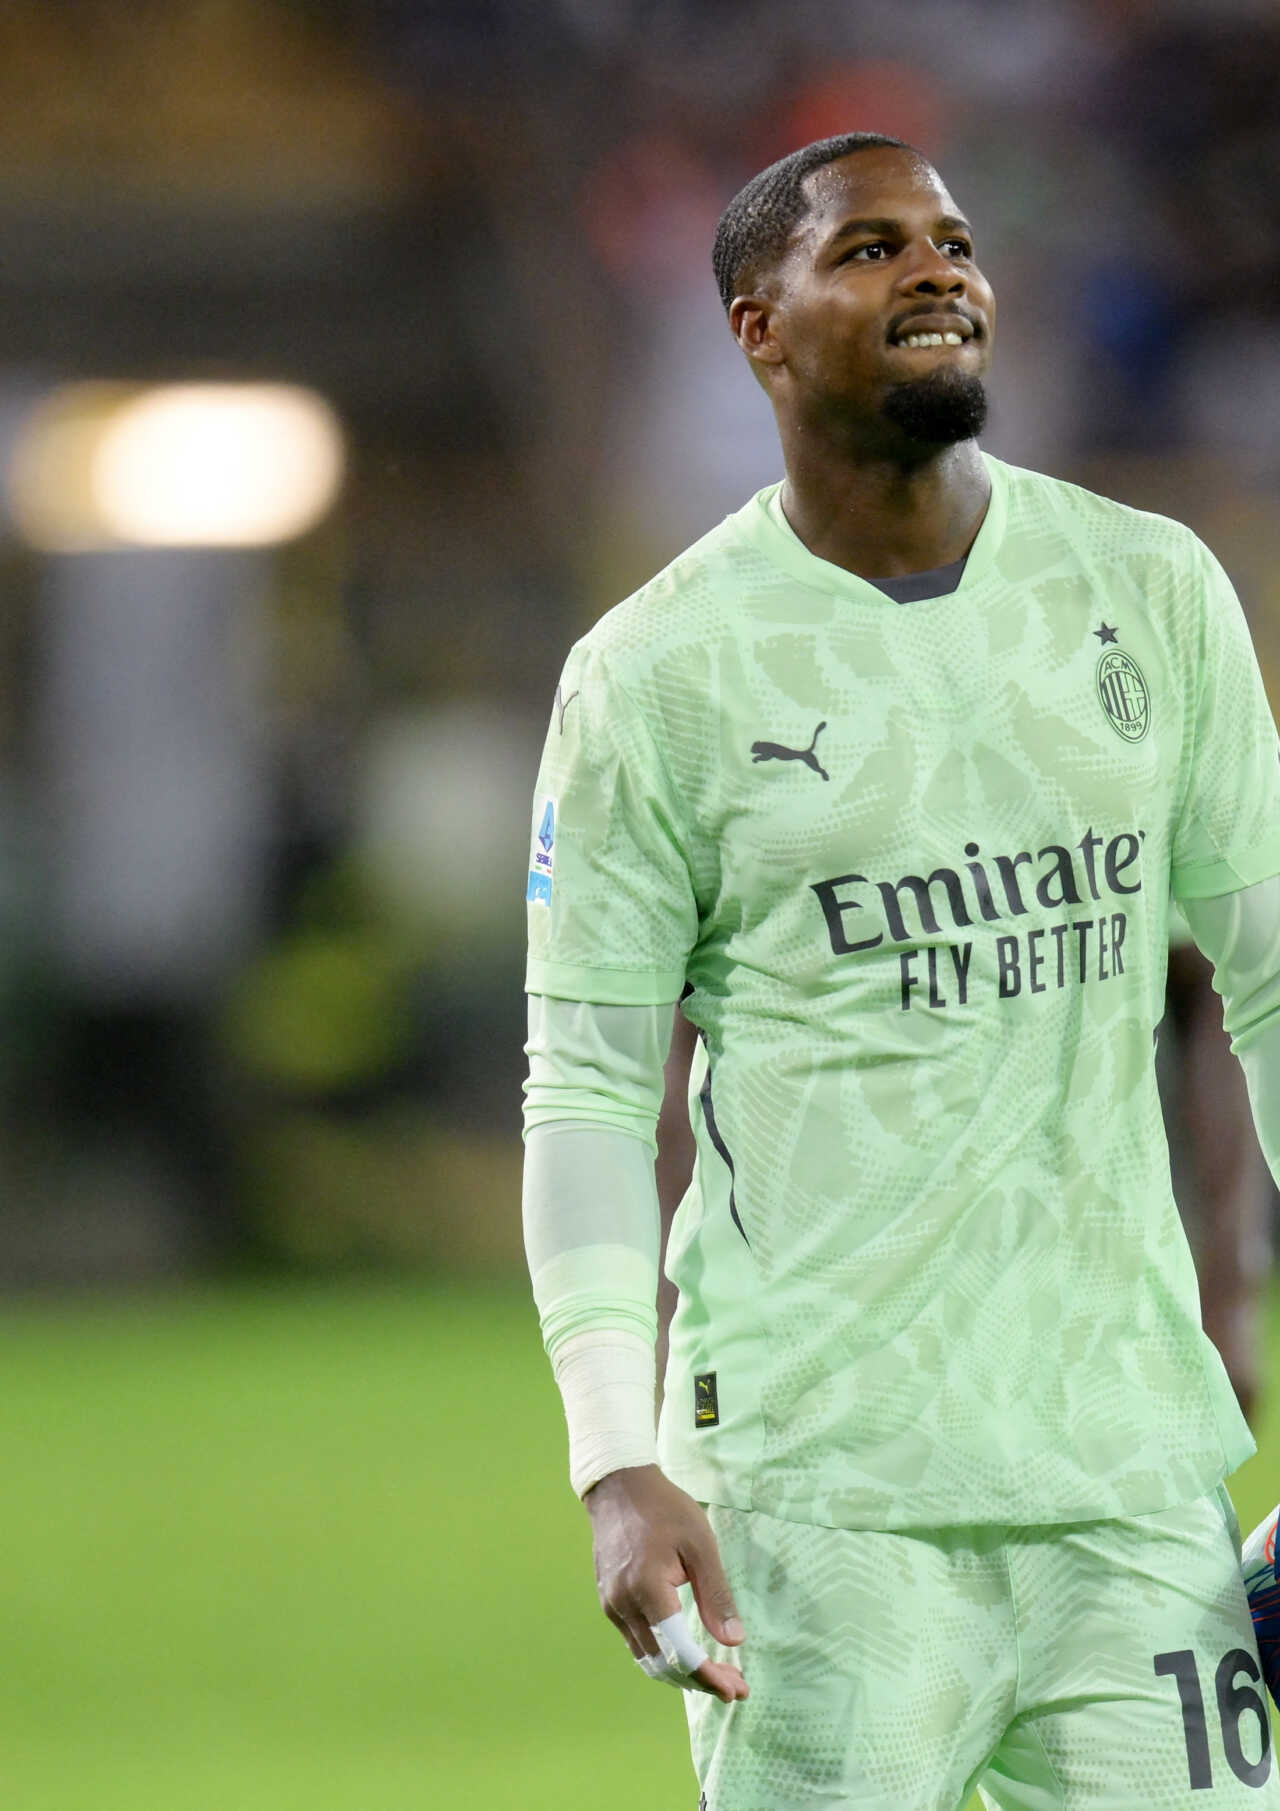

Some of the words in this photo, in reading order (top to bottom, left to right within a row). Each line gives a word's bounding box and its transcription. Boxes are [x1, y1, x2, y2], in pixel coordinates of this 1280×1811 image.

[1104, 657, 1132, 675] ACM
[1120, 720, 1143, 732] 1899
[808, 826, 1146, 956] Emirate
[900, 942, 973, 1012] FLY
[996, 912, 1127, 999] BETTER
[1153, 1648, 1272, 1790] 16
